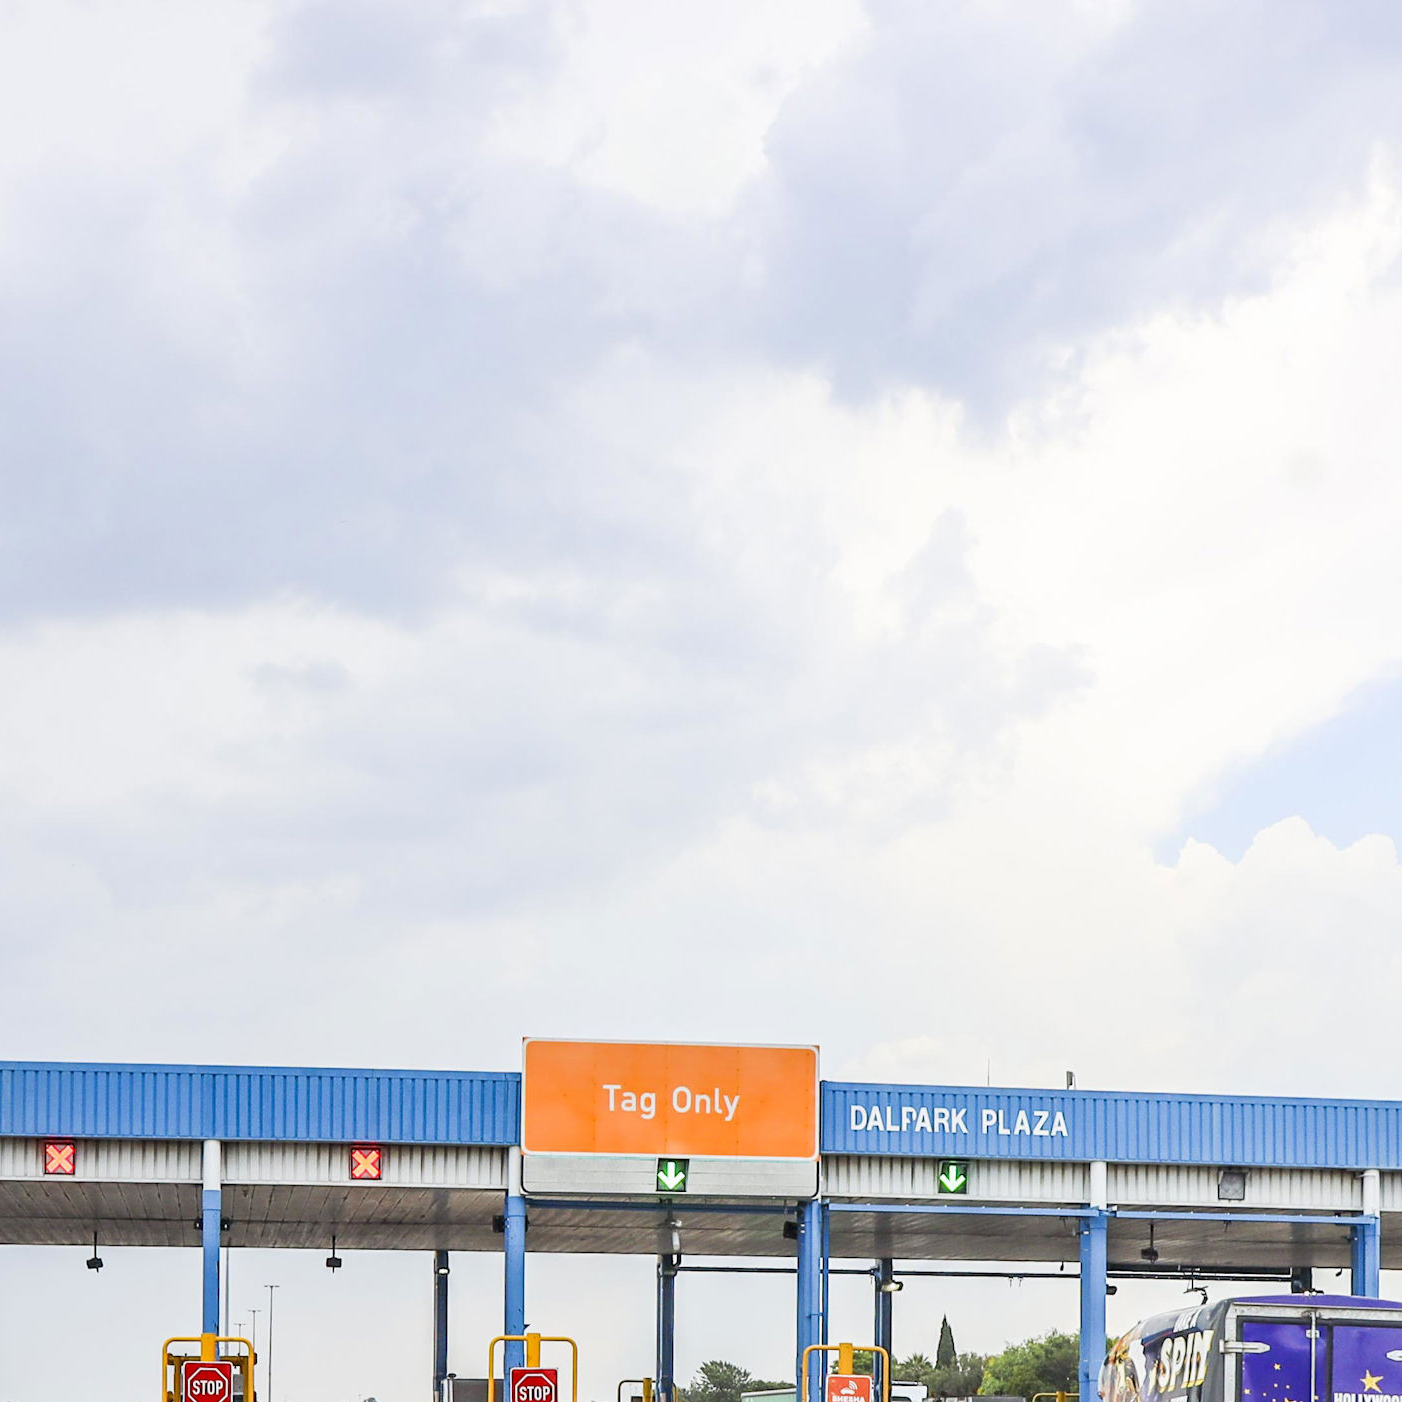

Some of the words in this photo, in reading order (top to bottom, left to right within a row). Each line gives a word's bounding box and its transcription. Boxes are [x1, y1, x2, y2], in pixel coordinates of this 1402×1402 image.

[602, 1084, 656, 1120] Tag
[672, 1086, 740, 1122] Only
[850, 1104, 968, 1134] DALPARK
[982, 1109, 1068, 1137] PLAZA
[1158, 1329, 1214, 1394] SPIN
[192, 1380, 223, 1396] STOP
[519, 1385, 551, 1401] STOP
